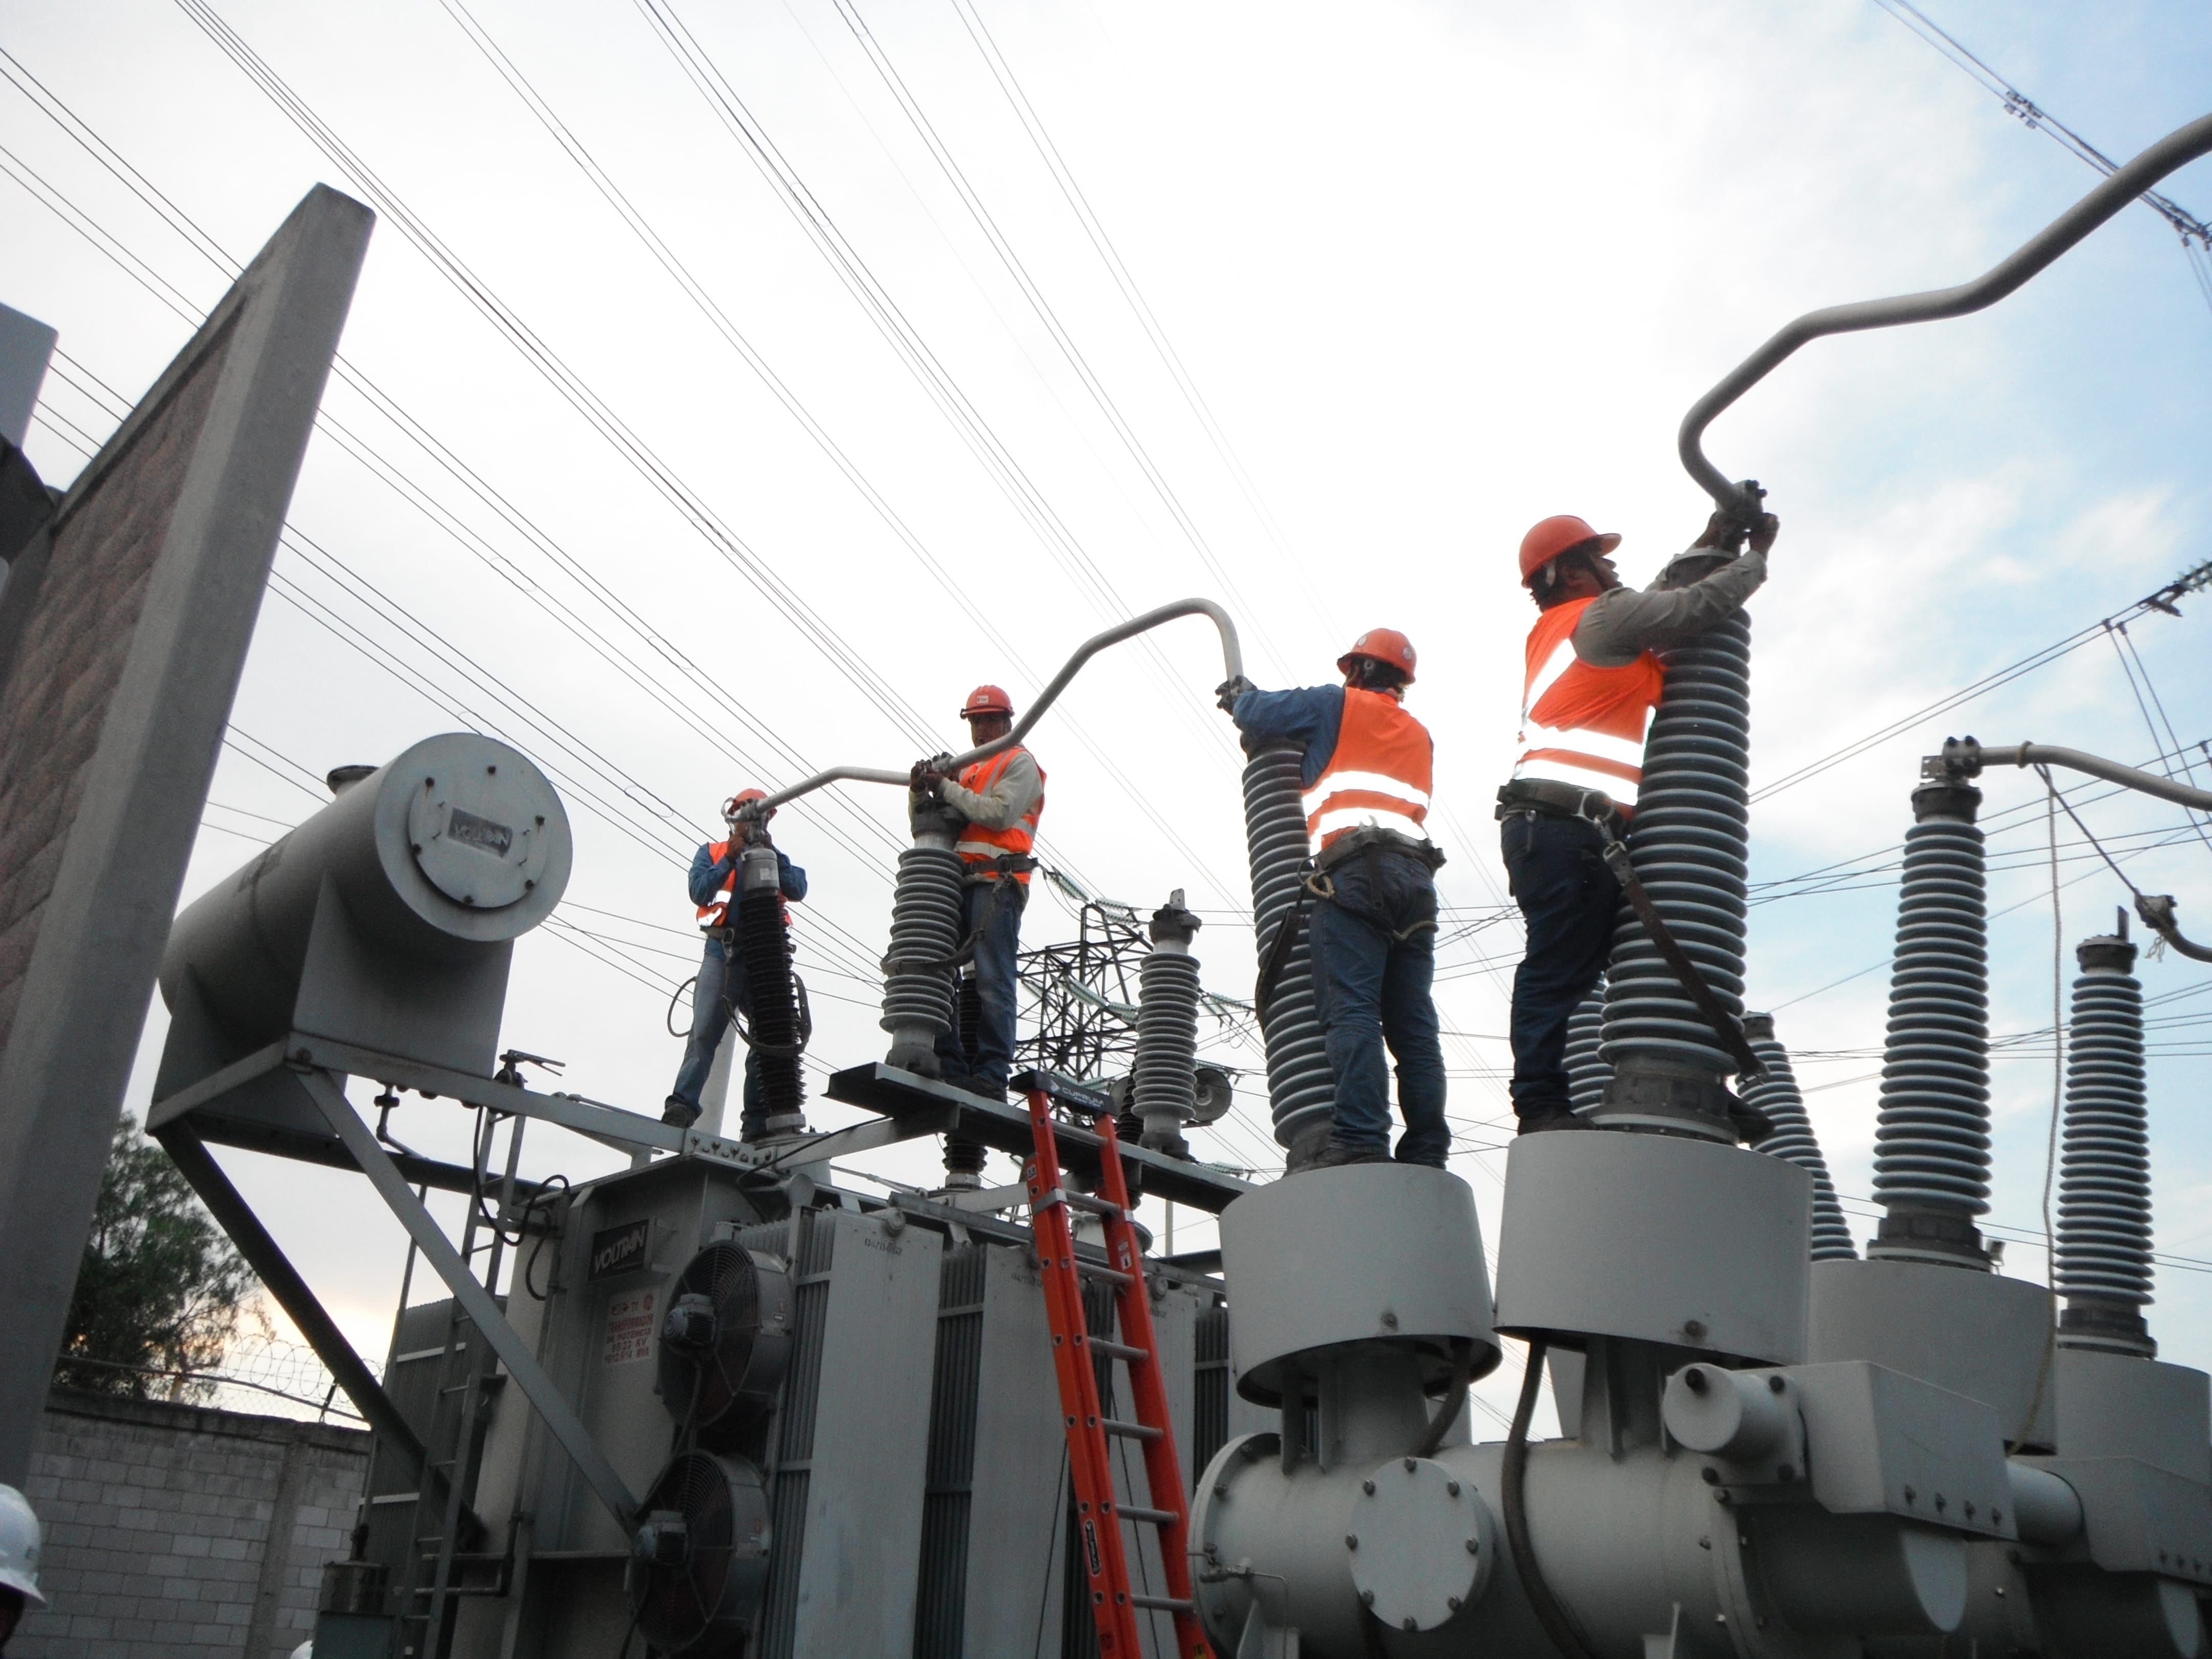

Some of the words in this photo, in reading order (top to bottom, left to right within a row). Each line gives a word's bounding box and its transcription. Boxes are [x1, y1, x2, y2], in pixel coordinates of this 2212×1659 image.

[1062, 1087, 1104, 1105] CUPRUM
[594, 1225, 646, 1274] VOLTRAN
[606, 1335, 614, 1345] DE
[618, 1328, 651, 1341] POTENCIA
[636, 1337, 647, 1348] KV
